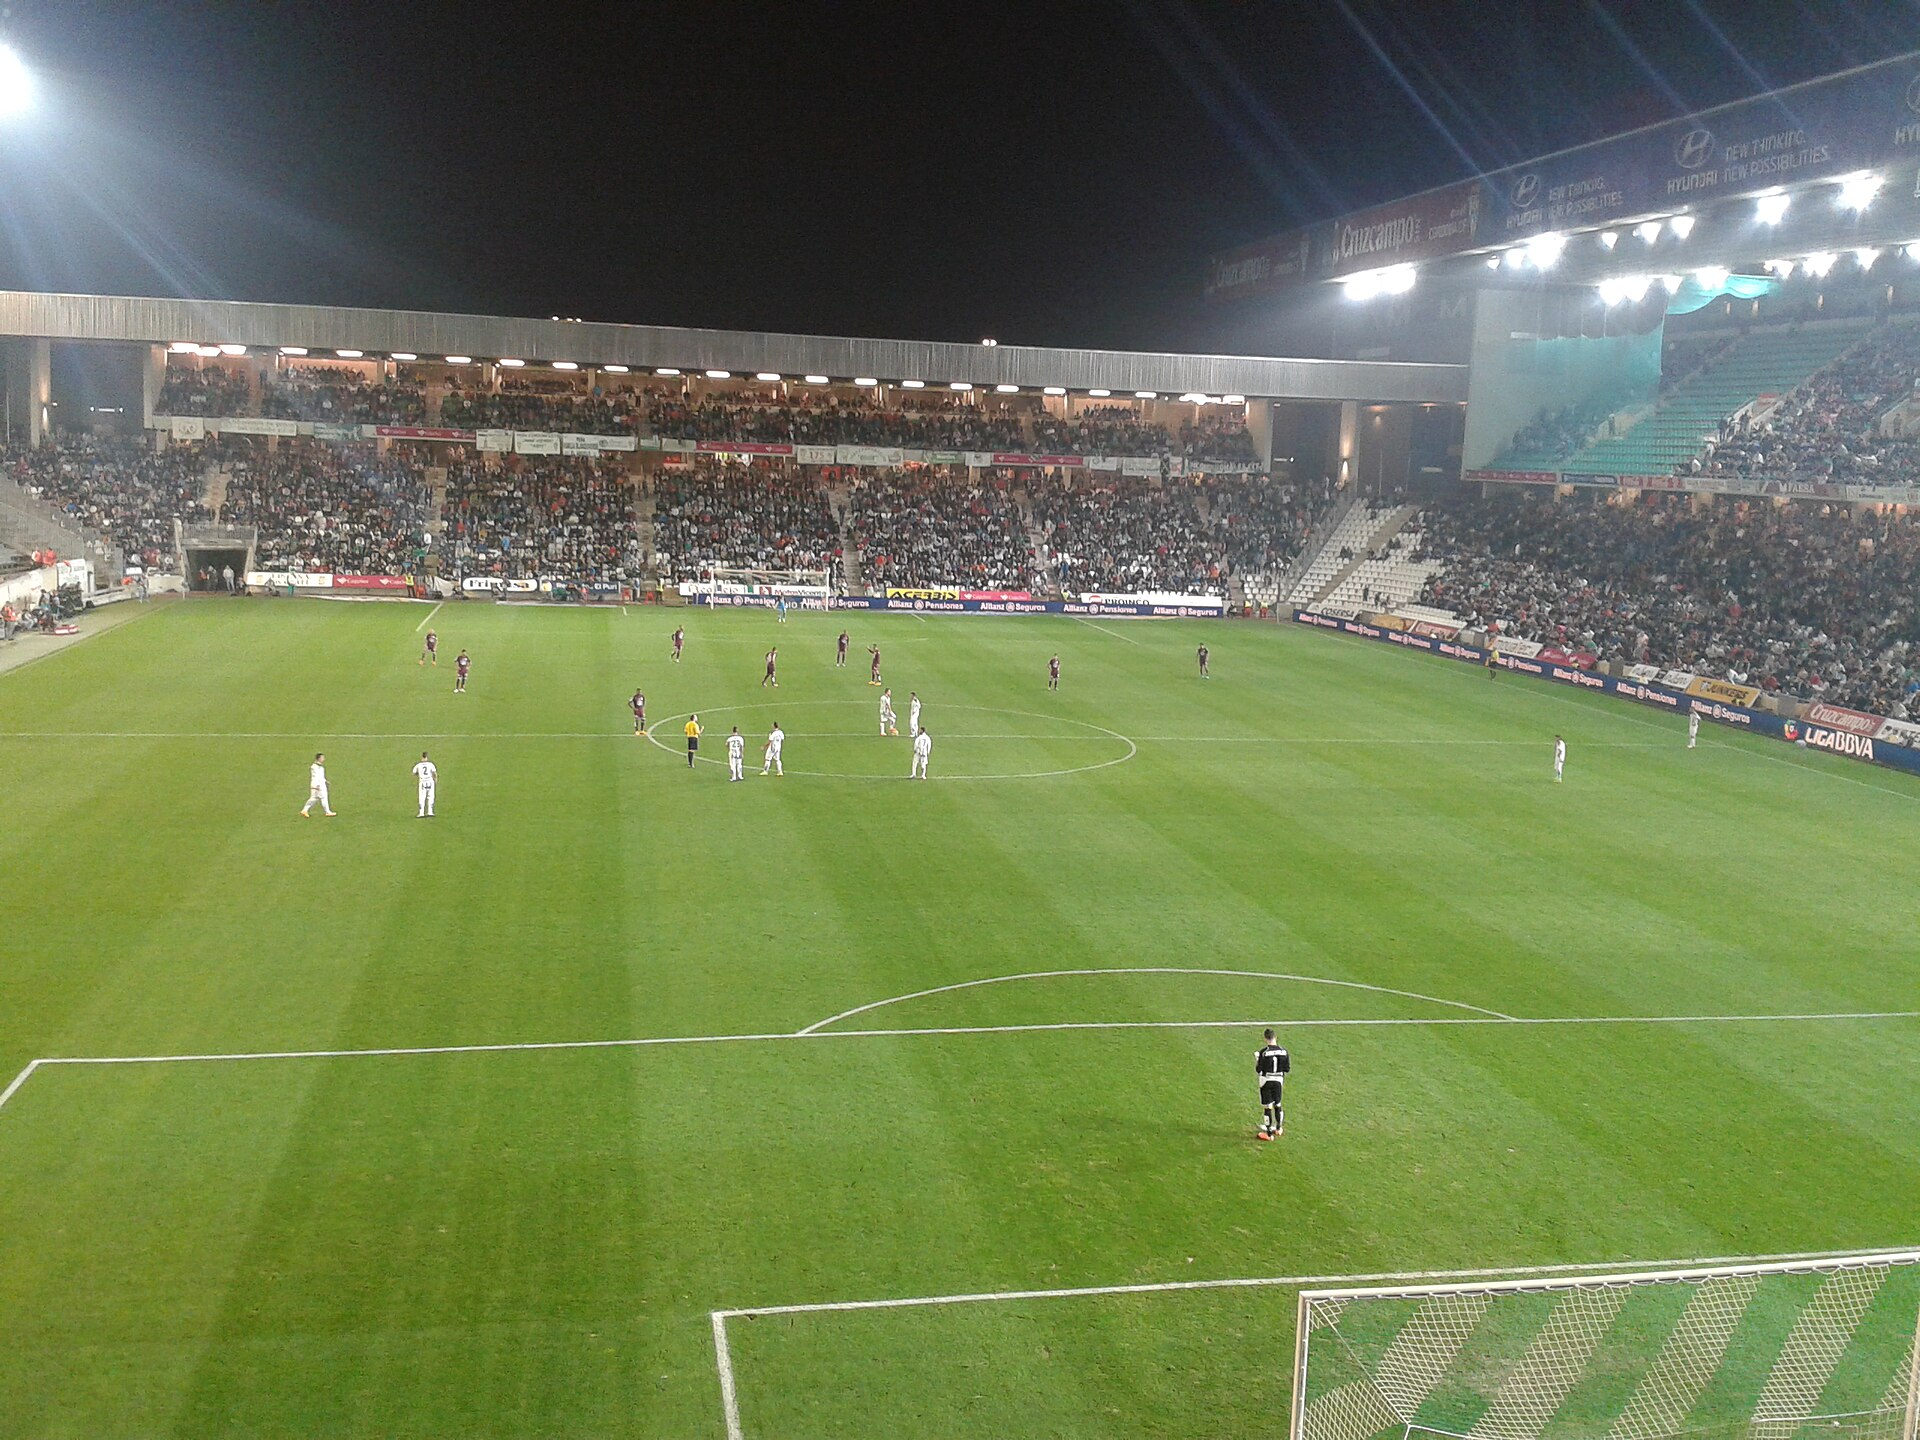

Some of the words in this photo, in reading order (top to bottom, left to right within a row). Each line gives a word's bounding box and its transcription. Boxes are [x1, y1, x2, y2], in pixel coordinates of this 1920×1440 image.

[1667, 169, 1719, 195] HYUNDAI
[1341, 215, 1414, 257] Cruzcampo
[888, 600, 913, 609] Allianz
[925, 601, 964, 610] Pensiones
[981, 602, 1005, 611] Allianz
[1015, 603, 1046, 613] Seguros
[1063, 604, 1088, 613] Allianz
[1100, 605, 1138, 614] Pensiones
[1153, 606, 1178, 615] Allianz
[1187, 607, 1218, 618] Seguros
[1616, 681, 1636, 695] Allianz
[1645, 688, 1677, 706] Pensiones
[1691, 700, 1712, 715] Allianz
[1721, 707, 1751, 724] Seguros
[1810, 704, 1871, 731] Cruzcampo
[1272, 1055, 1278, 1073] 1
